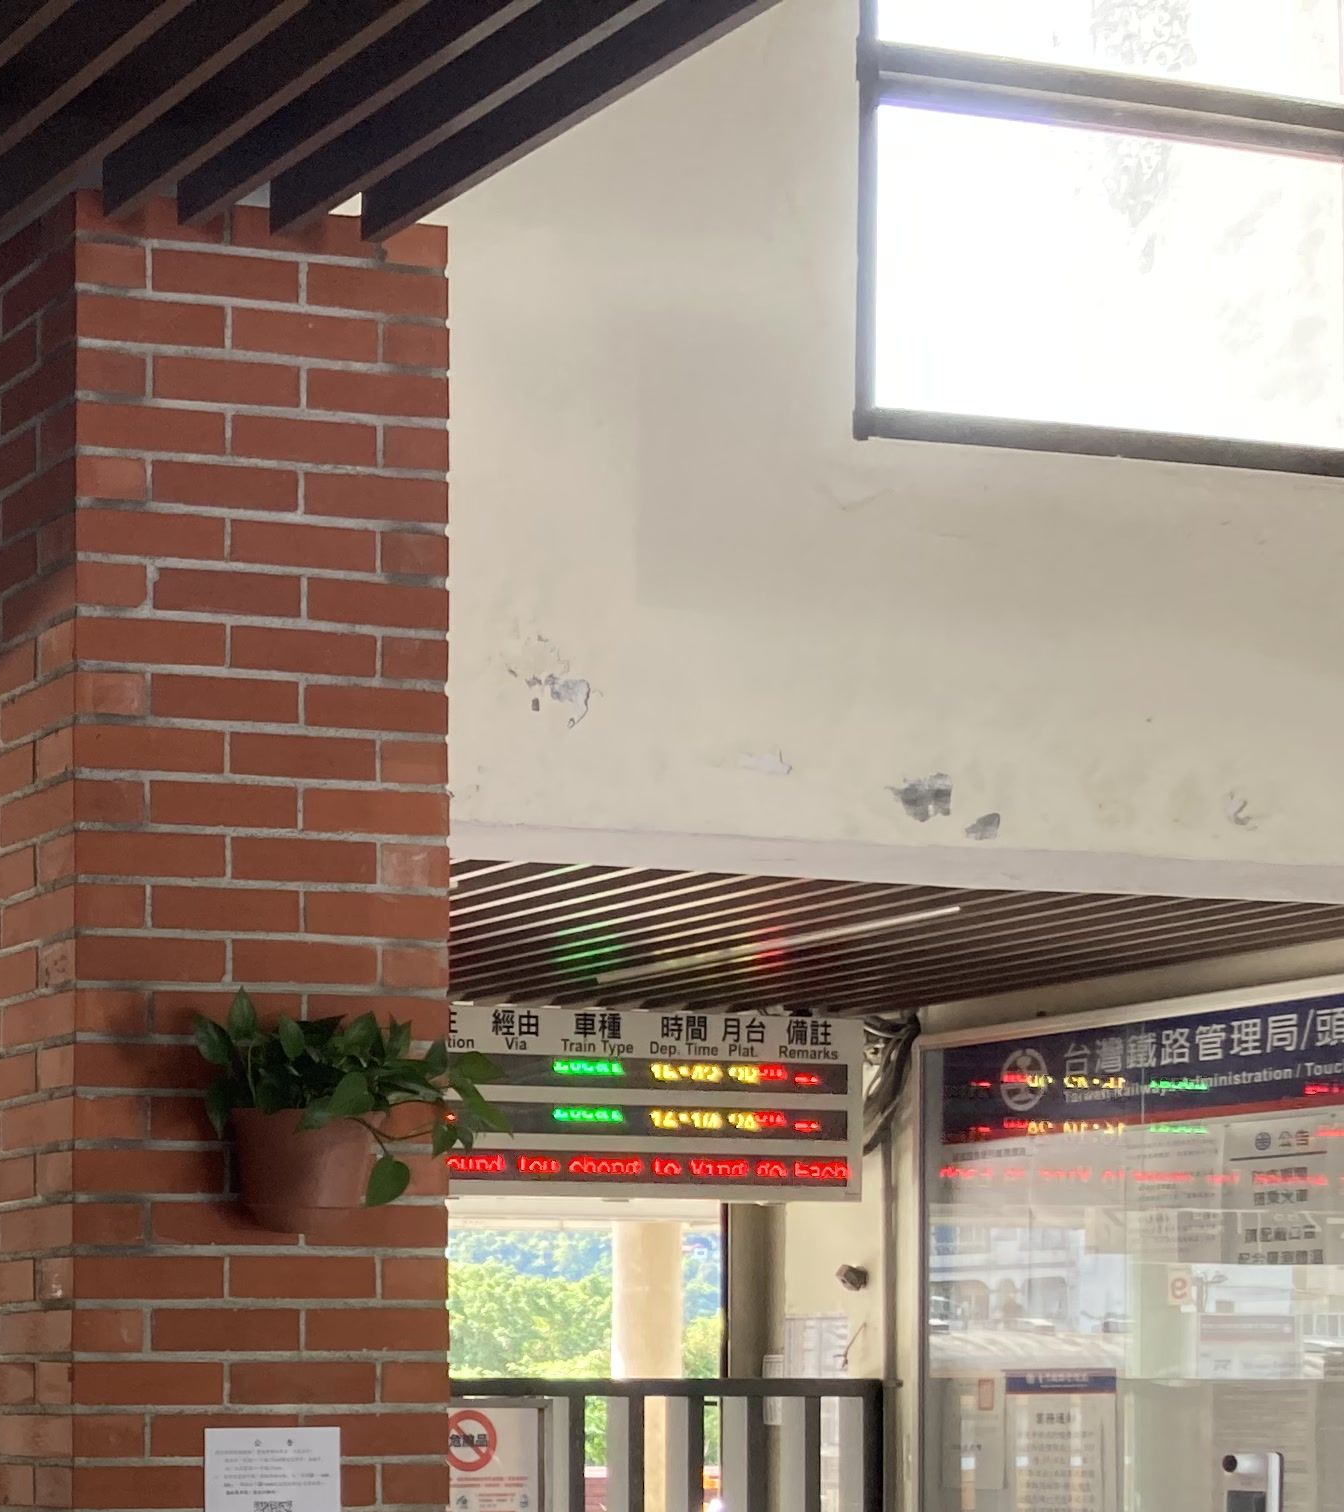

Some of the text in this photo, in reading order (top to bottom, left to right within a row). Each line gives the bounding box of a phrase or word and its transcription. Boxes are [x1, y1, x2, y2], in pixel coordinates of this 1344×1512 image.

[492, 1010, 832, 1046] 經由 車種 時間 月台 備註
[505, 1037, 838, 1060] Via Train Type Dep. Time Plat. Remarks
